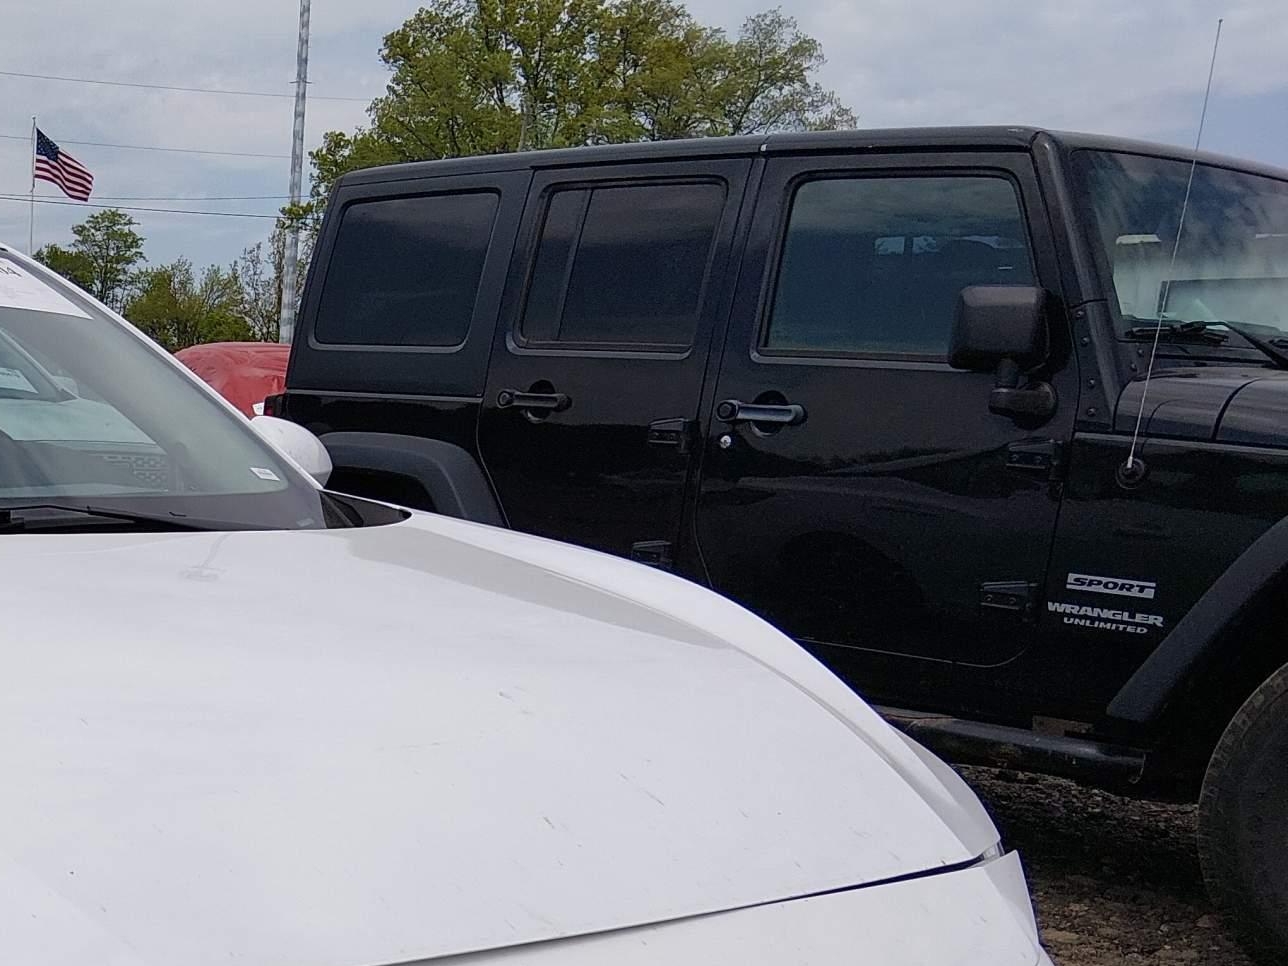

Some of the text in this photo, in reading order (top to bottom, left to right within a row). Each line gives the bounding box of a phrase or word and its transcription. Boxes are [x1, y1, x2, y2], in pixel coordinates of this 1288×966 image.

[1069, 575, 1155, 596] SPORT
[1047, 601, 1164, 628] WRANGLER
[1063, 616, 1149, 634] UNLIMITED
